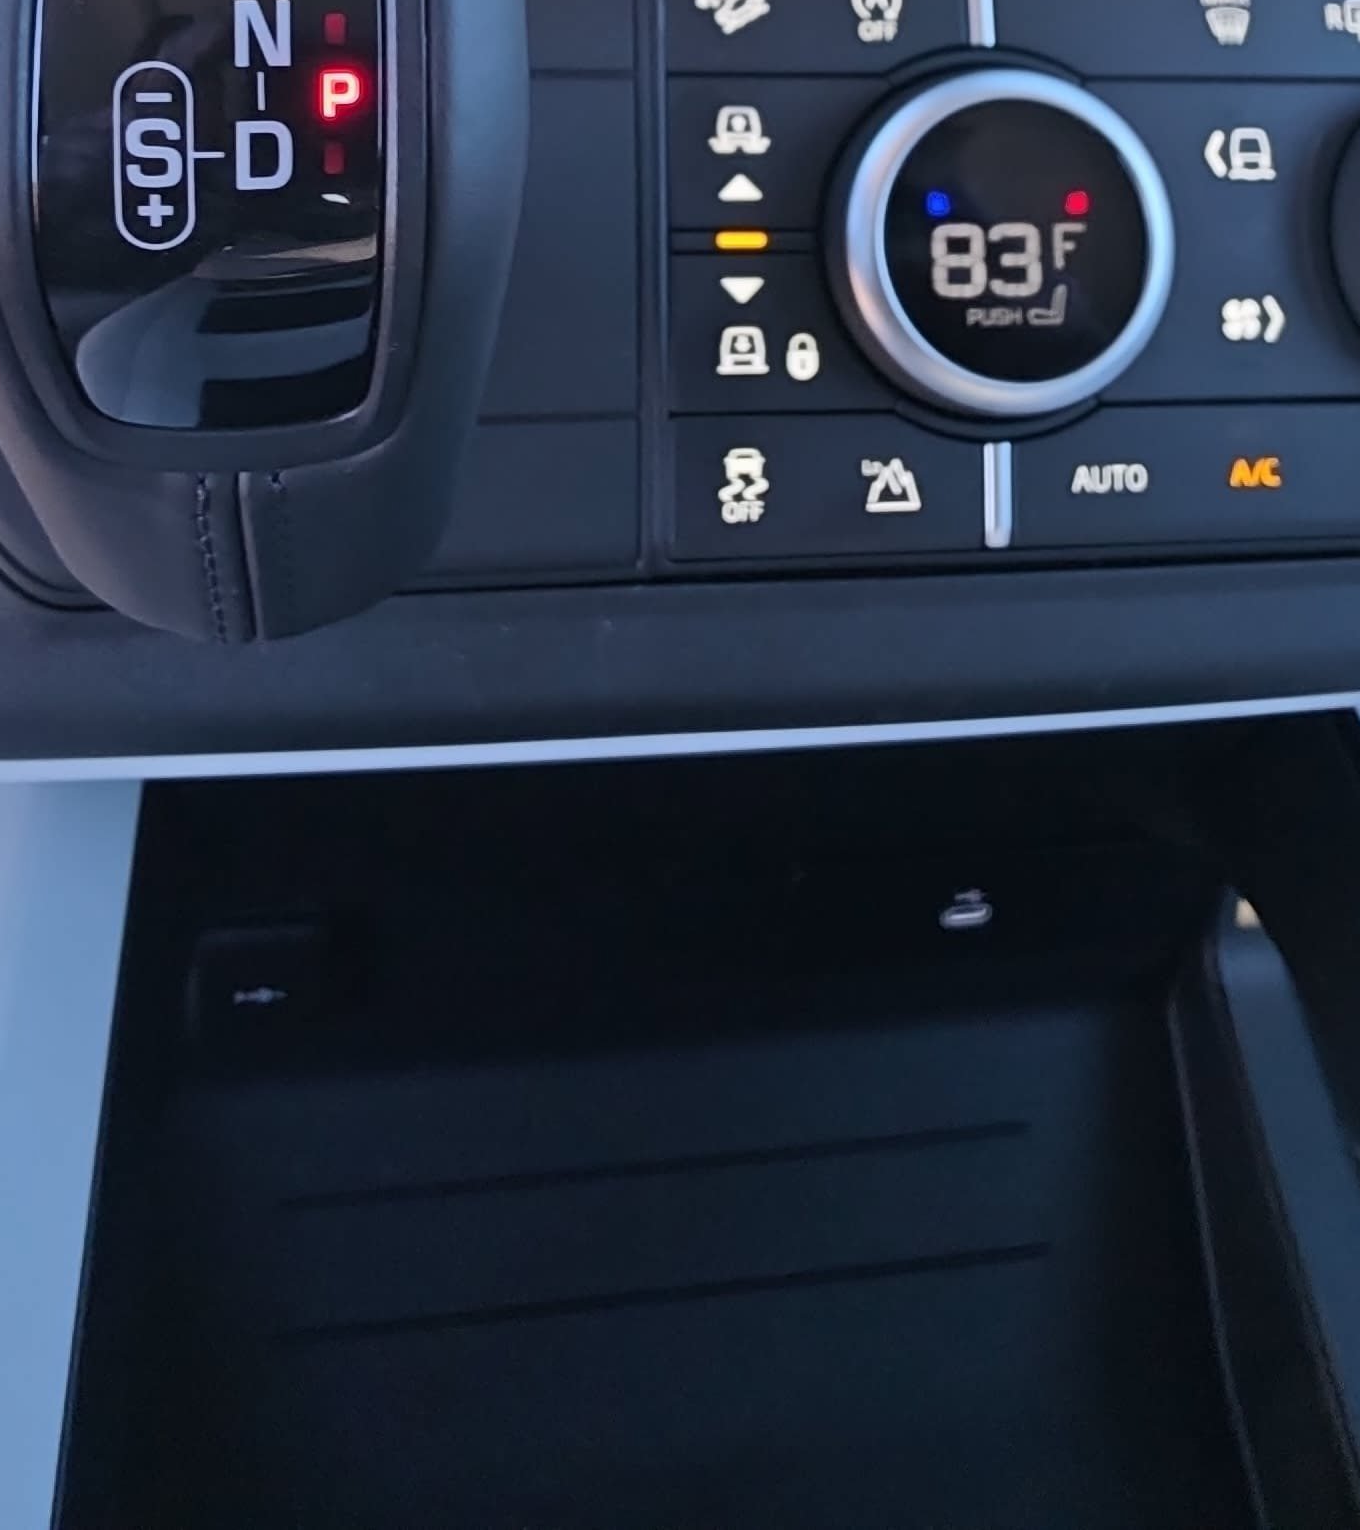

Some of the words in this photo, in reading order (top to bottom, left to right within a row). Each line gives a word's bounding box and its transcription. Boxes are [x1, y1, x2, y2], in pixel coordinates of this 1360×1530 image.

[857, 19, 899, 43] OFF
[321, 72, 362, 119] P
[124, 117, 184, 189] S
[235, 120, 294, 191] D
[930, 222, 1044, 299] 83
[1052, 221, 1088, 270] F
[965, 306, 1024, 327] PUSH
[1070, 462, 1149, 494] AUTO
[1229, 457, 1283, 488] A/C
[721, 499, 766, 524] OFF
